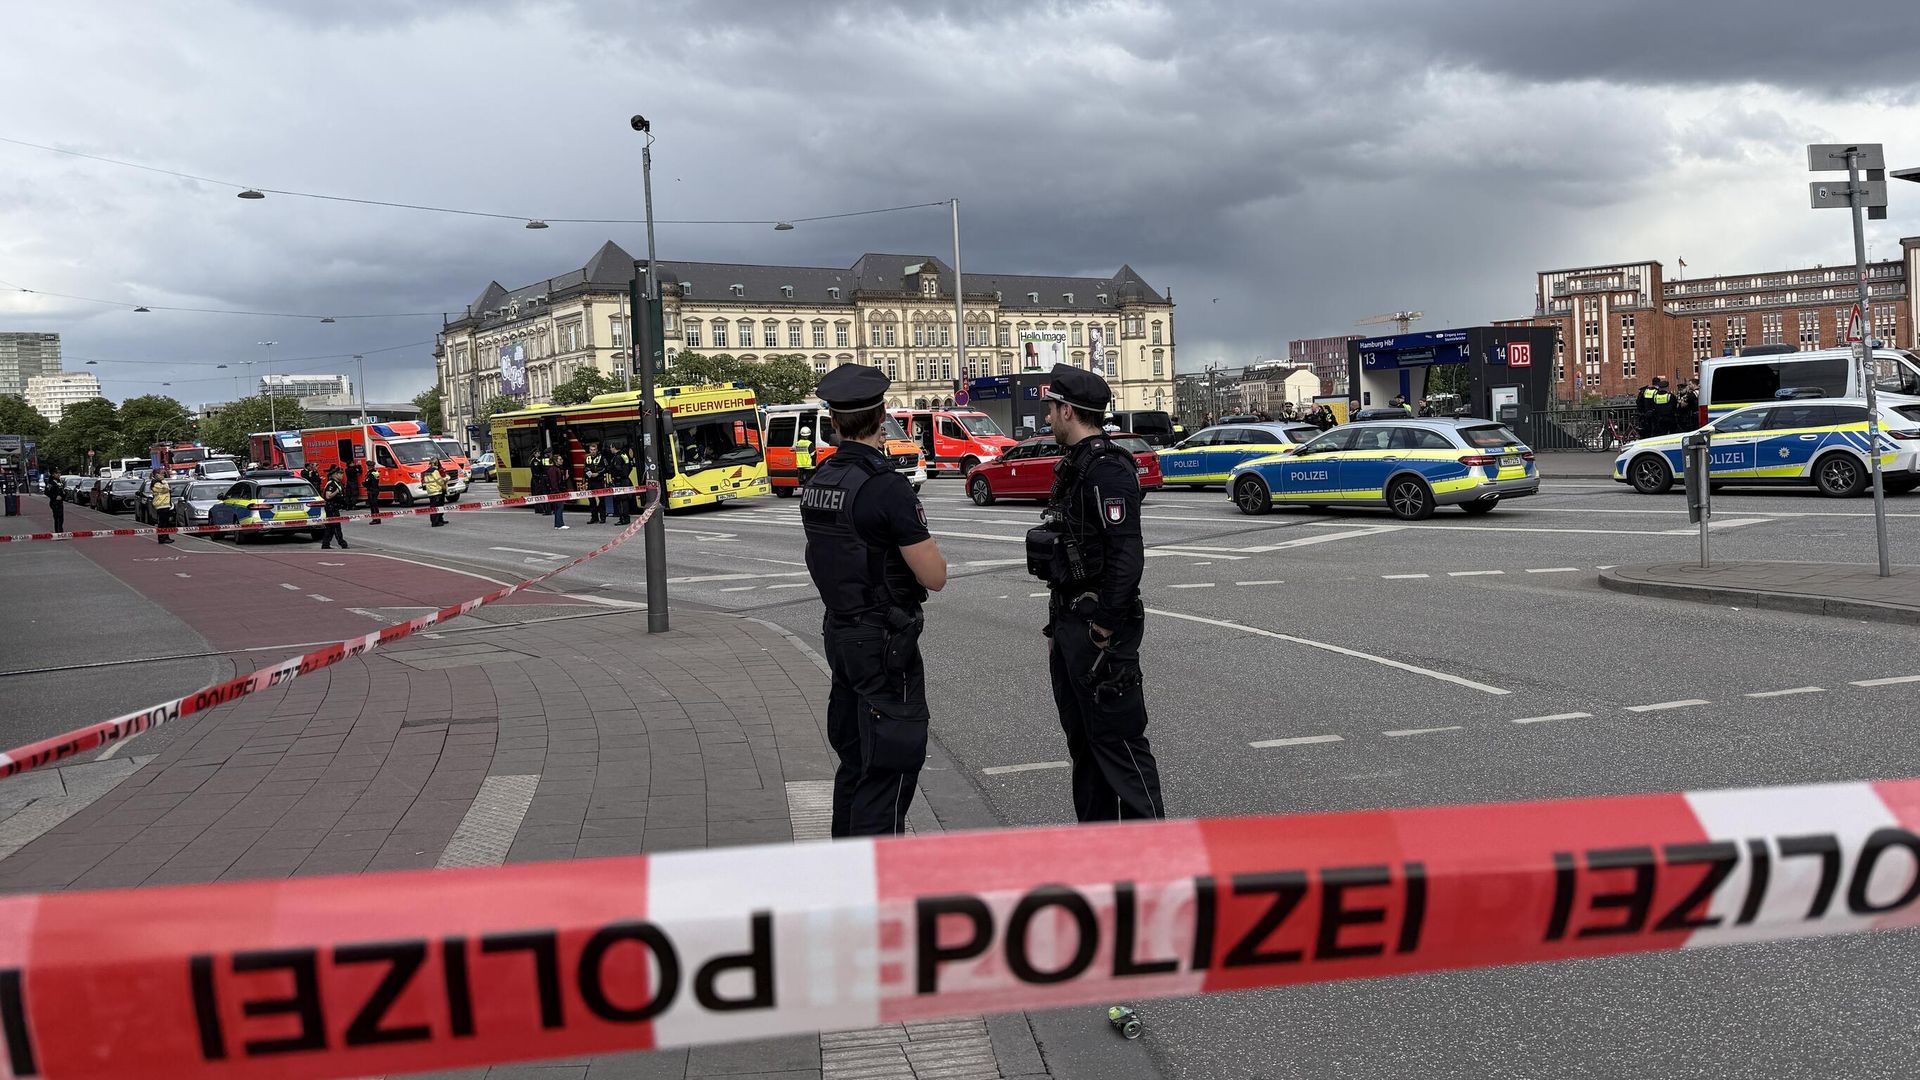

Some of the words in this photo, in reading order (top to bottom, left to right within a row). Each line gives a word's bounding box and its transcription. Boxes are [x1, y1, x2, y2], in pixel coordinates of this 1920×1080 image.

[1021, 332, 1040, 341] Hello
[1042, 332, 1066, 343] Image
[1360, 341, 1384, 349] Hamburg
[1458, 344, 1470, 357] 14
[1364, 352, 1376, 365] 13
[1496, 347, 1506, 360] 14
[1512, 346, 1529, 363] DB
[689, 384, 725, 392] FEUERWEHR
[1029, 388, 1038, 396] 12
[679, 398, 744, 413] FEUERWEHR
[1173, 460, 1200, 468] POLIZEI
[1709, 452, 1744, 465] LIZEI
[1291, 470, 1329, 481] POLIZEI
[801, 488, 846, 510] POLIZEI
[1522, 826, 1920, 944] OLIZEI
[914, 861, 1428, 995] POLIZEI
[186, 908, 777, 1061] POLIZEI
